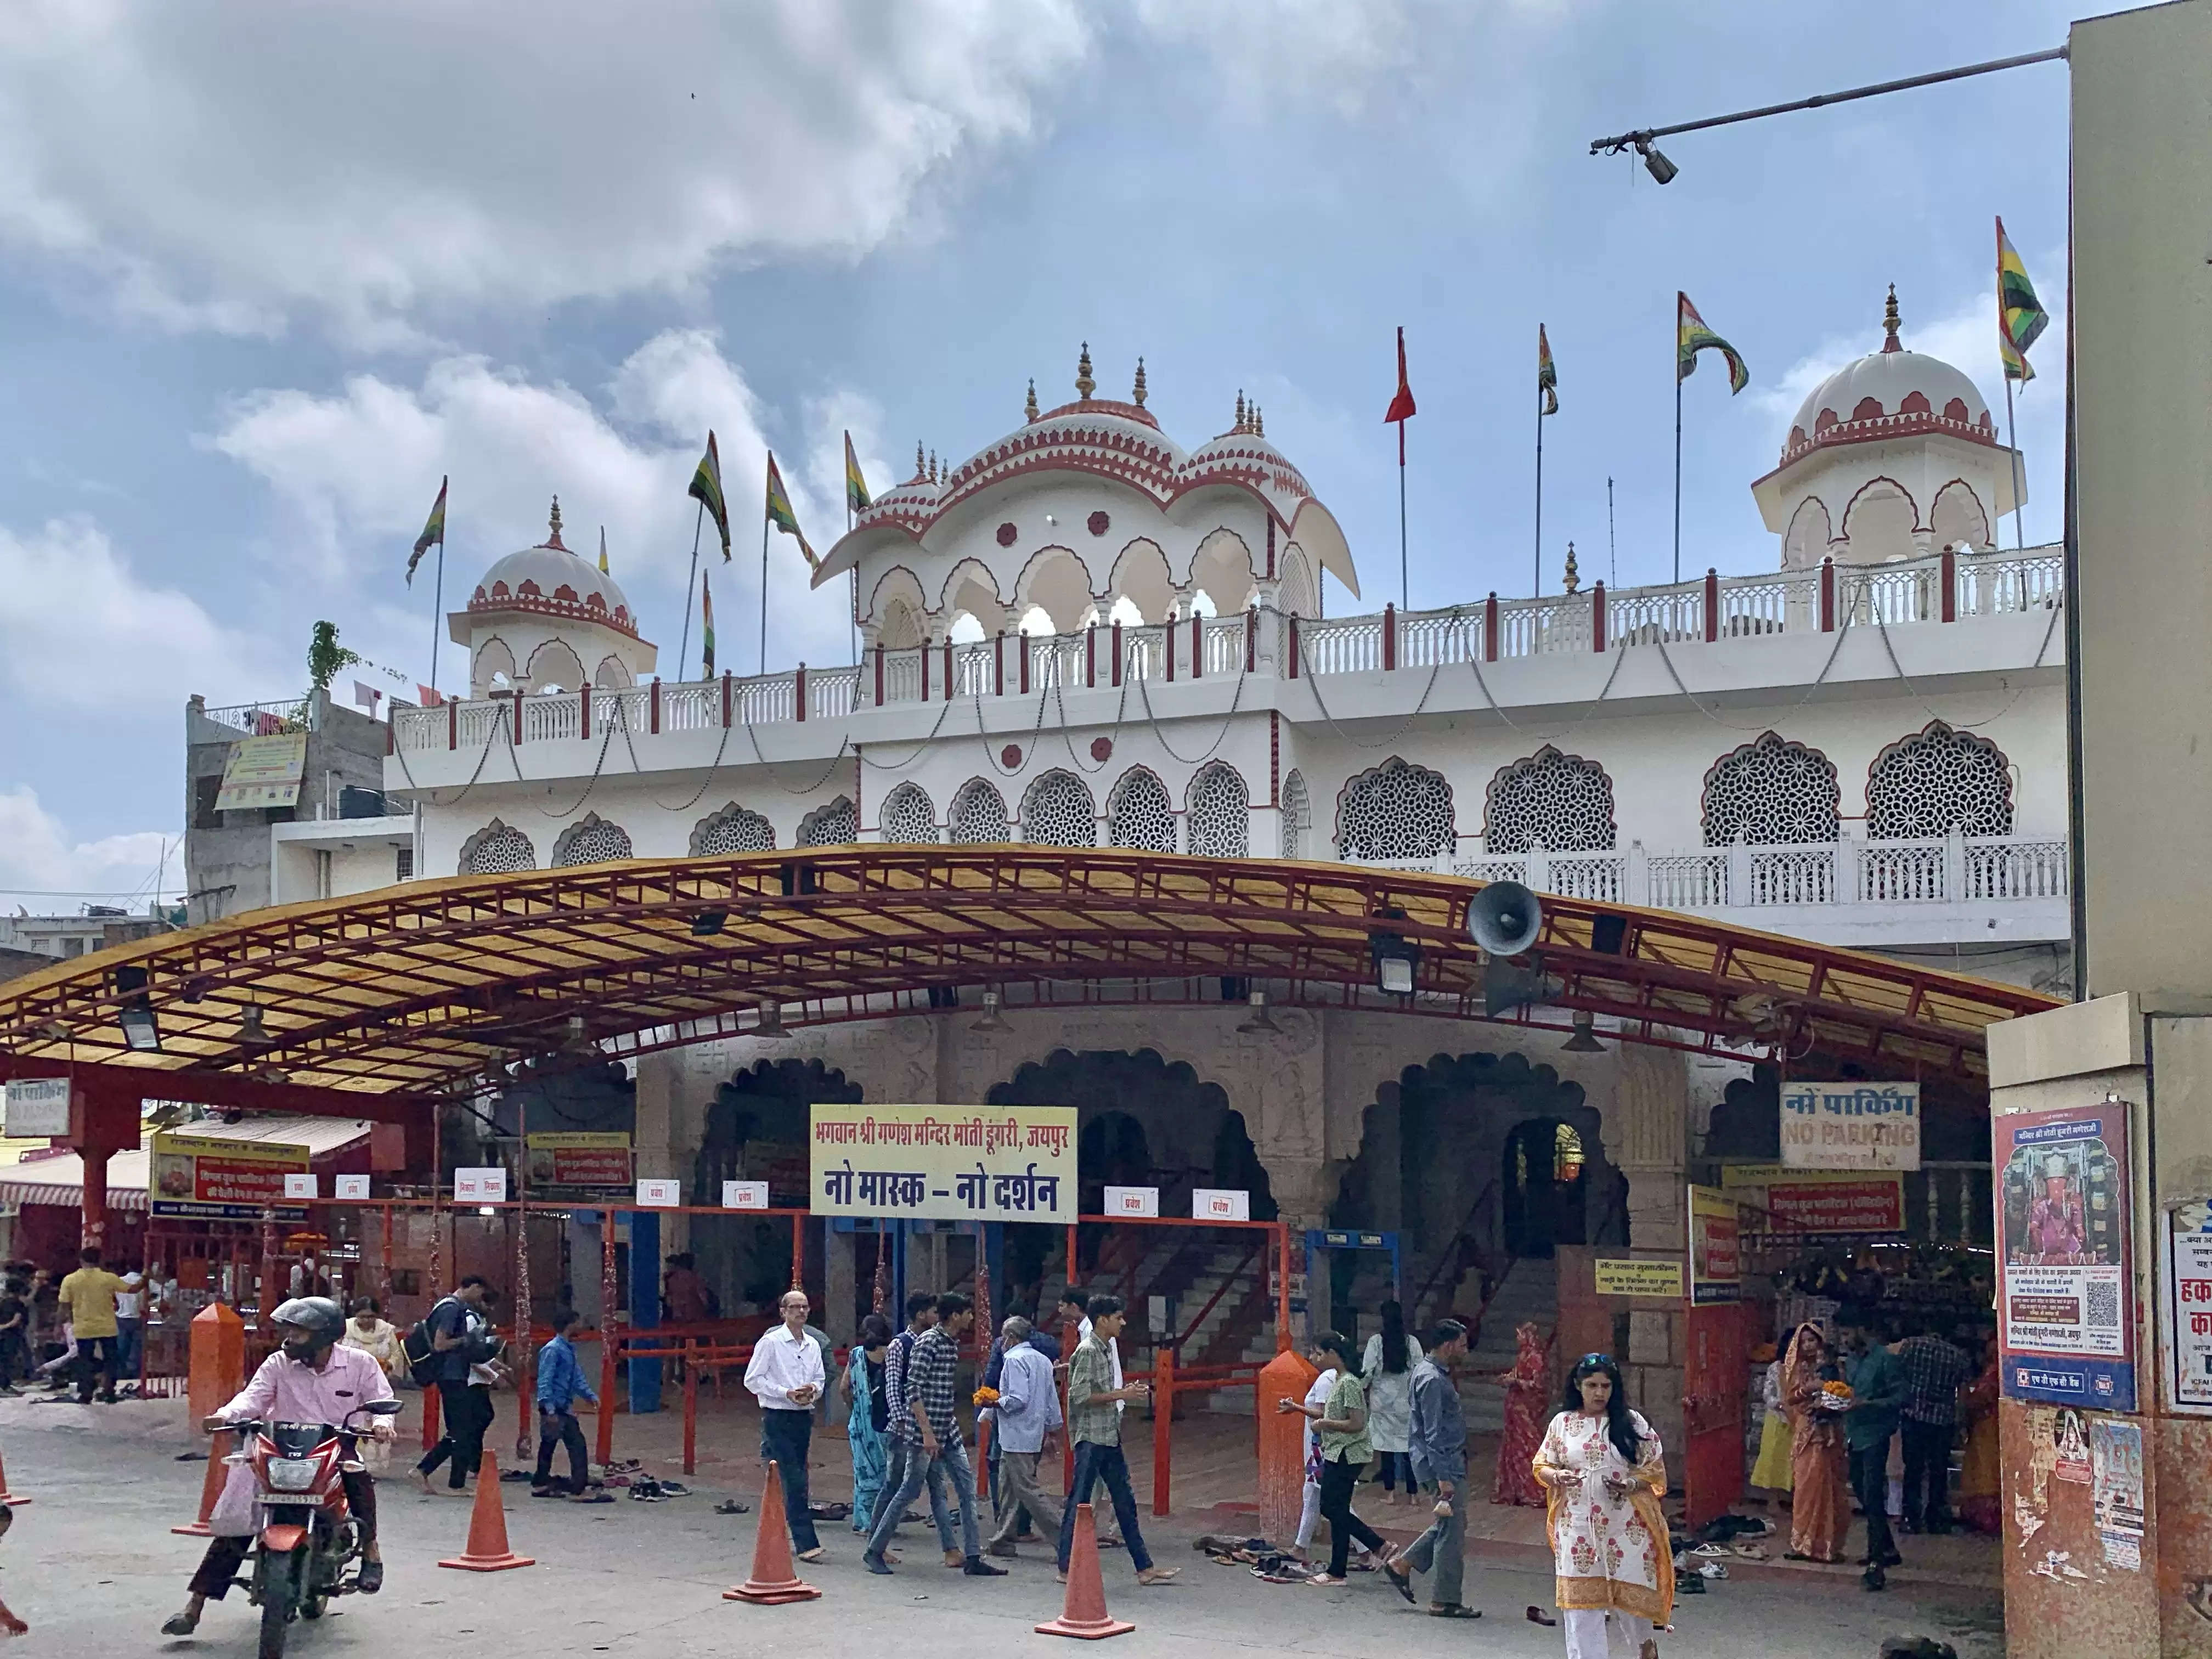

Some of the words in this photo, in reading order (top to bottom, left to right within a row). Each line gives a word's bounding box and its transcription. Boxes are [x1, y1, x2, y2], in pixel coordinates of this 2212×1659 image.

[816, 1122, 857, 1144] भगवान
[860, 1116, 876, 1144] श्री
[878, 1116, 913, 1146] गणेश
[915, 1116, 951, 1146] मन्दिर
[953, 1116, 983, 1146] मोती
[1026, 1125, 1069, 1158] जयपुर
[1785, 1123, 1814, 1144] NO
[1821, 1123, 1915, 1147] PARKING
[824, 1159, 855, 1205] नो
[858, 1171, 927, 1207] मास्क
[956, 1162, 989, 1209] नो
[993, 1163, 1060, 1212] दर्शन
[1125, 1197, 1140, 1209] प्रवेश
[1212, 1200, 1228, 1212] प्रवेश
